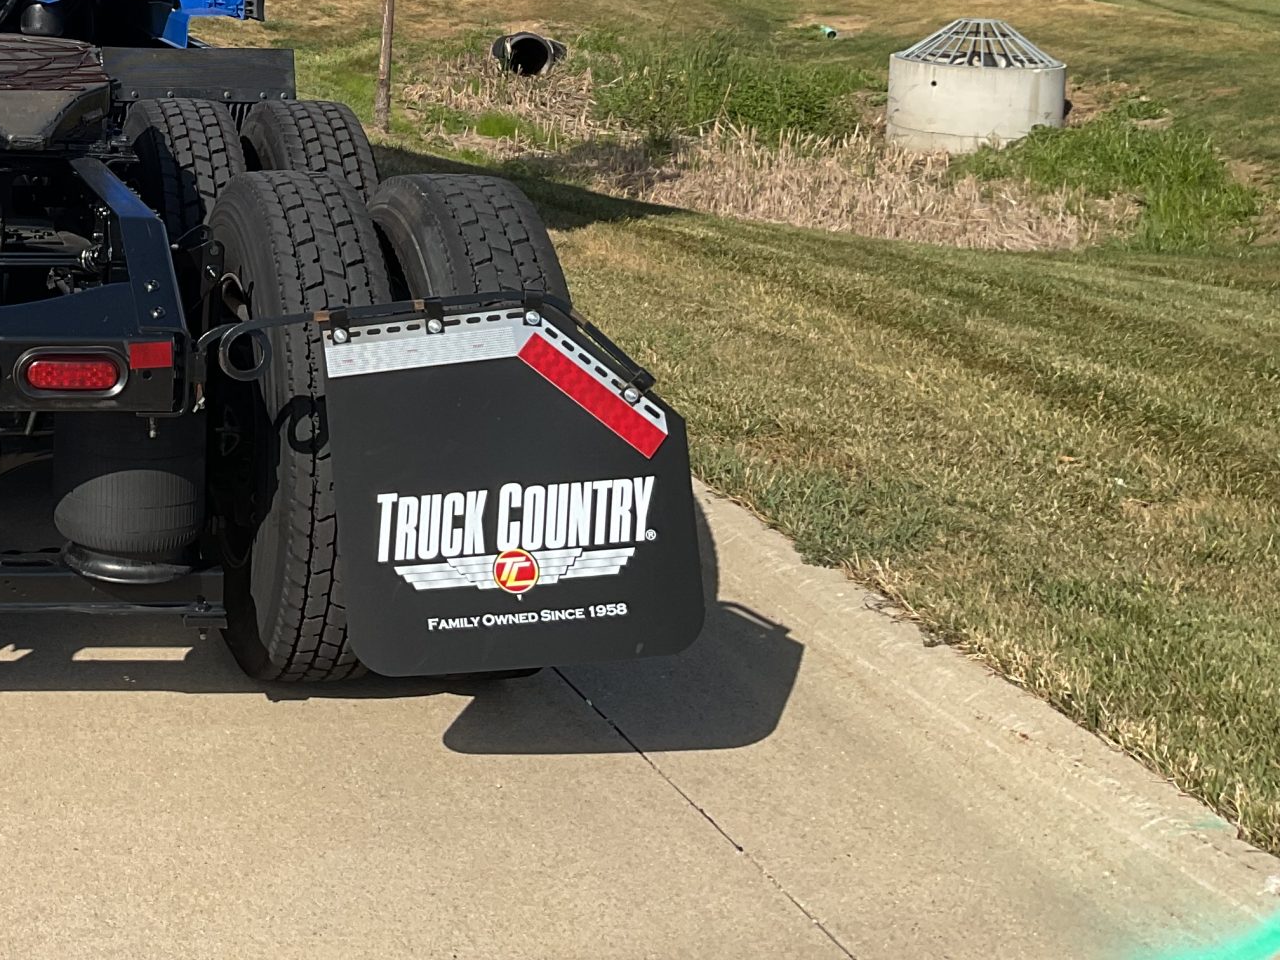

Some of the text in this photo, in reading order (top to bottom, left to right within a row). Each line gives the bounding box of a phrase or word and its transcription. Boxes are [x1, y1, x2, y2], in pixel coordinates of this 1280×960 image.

[377, 475, 656, 564] TRUCK COUNTRY
[427, 602, 628, 631] FAMILY OWNED SINCE 1958
